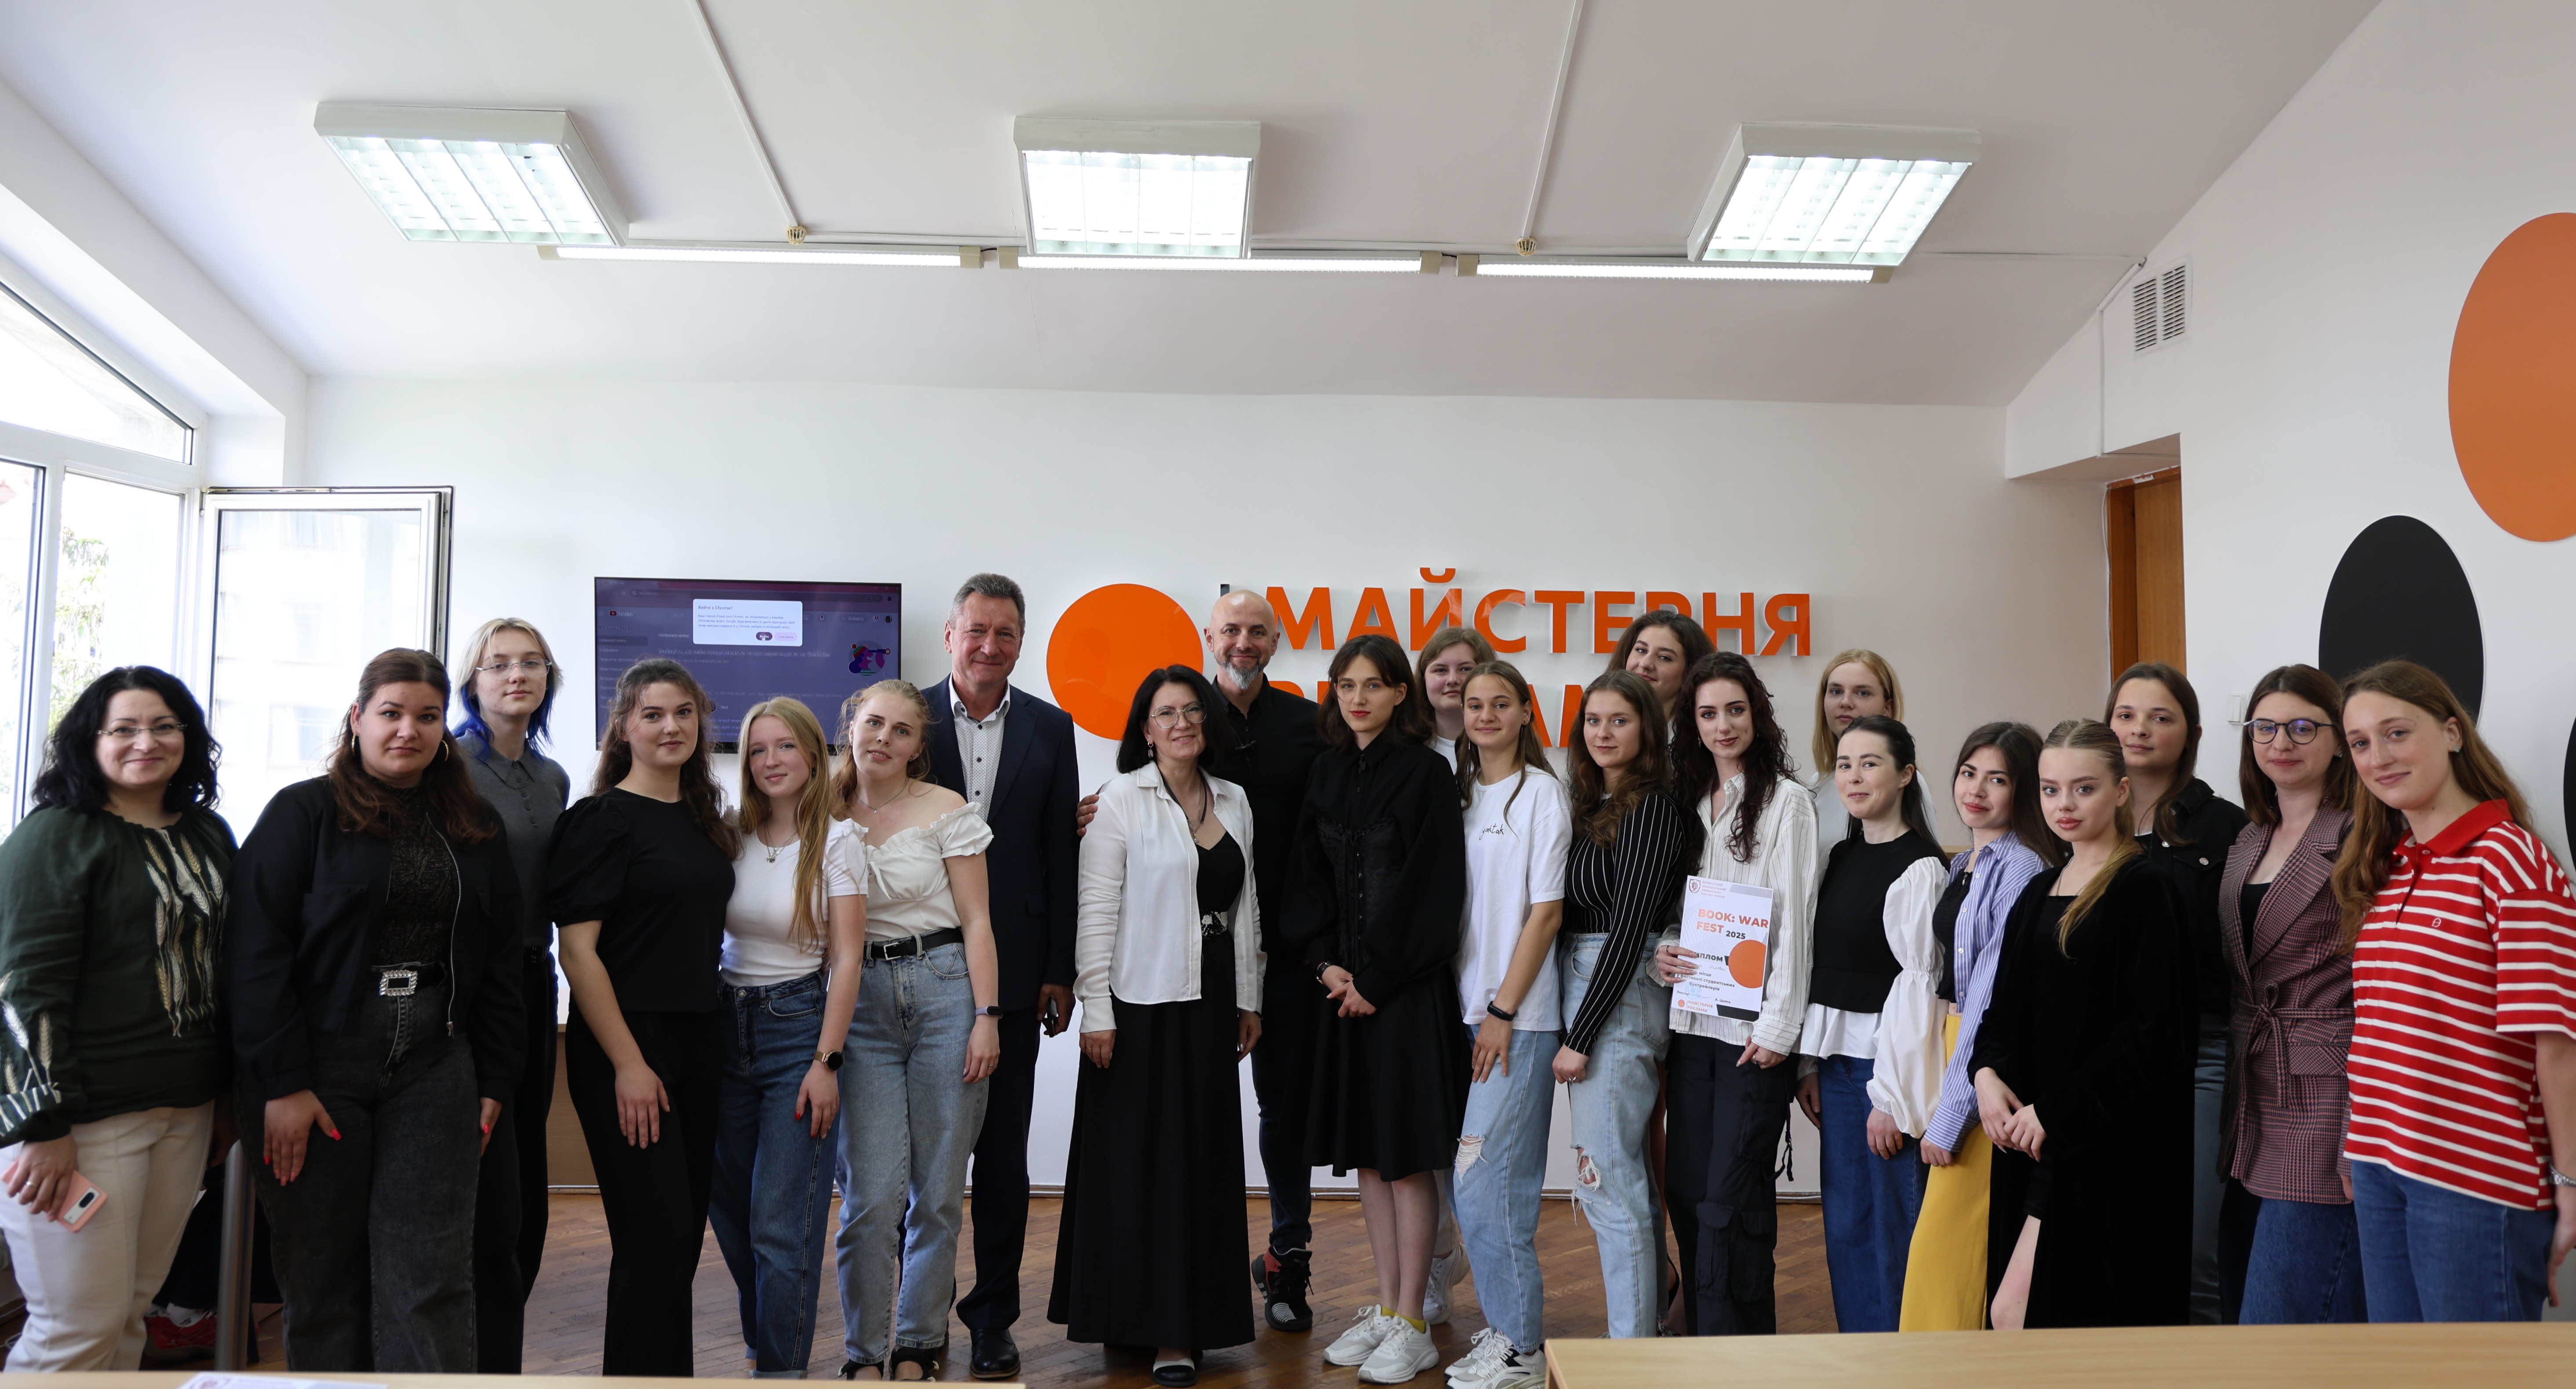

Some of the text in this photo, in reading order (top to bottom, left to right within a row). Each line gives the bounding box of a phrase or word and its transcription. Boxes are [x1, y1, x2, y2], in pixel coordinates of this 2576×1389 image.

[1479, 823, 1504, 840] yaktak
[1698, 908, 1769, 928] BOOK: WAR
[1697, 921, 1746, 939] FEST 2025
[1689, 982, 1720, 991] буктрейлерів
[1703, 979, 1735, 988] студентських
